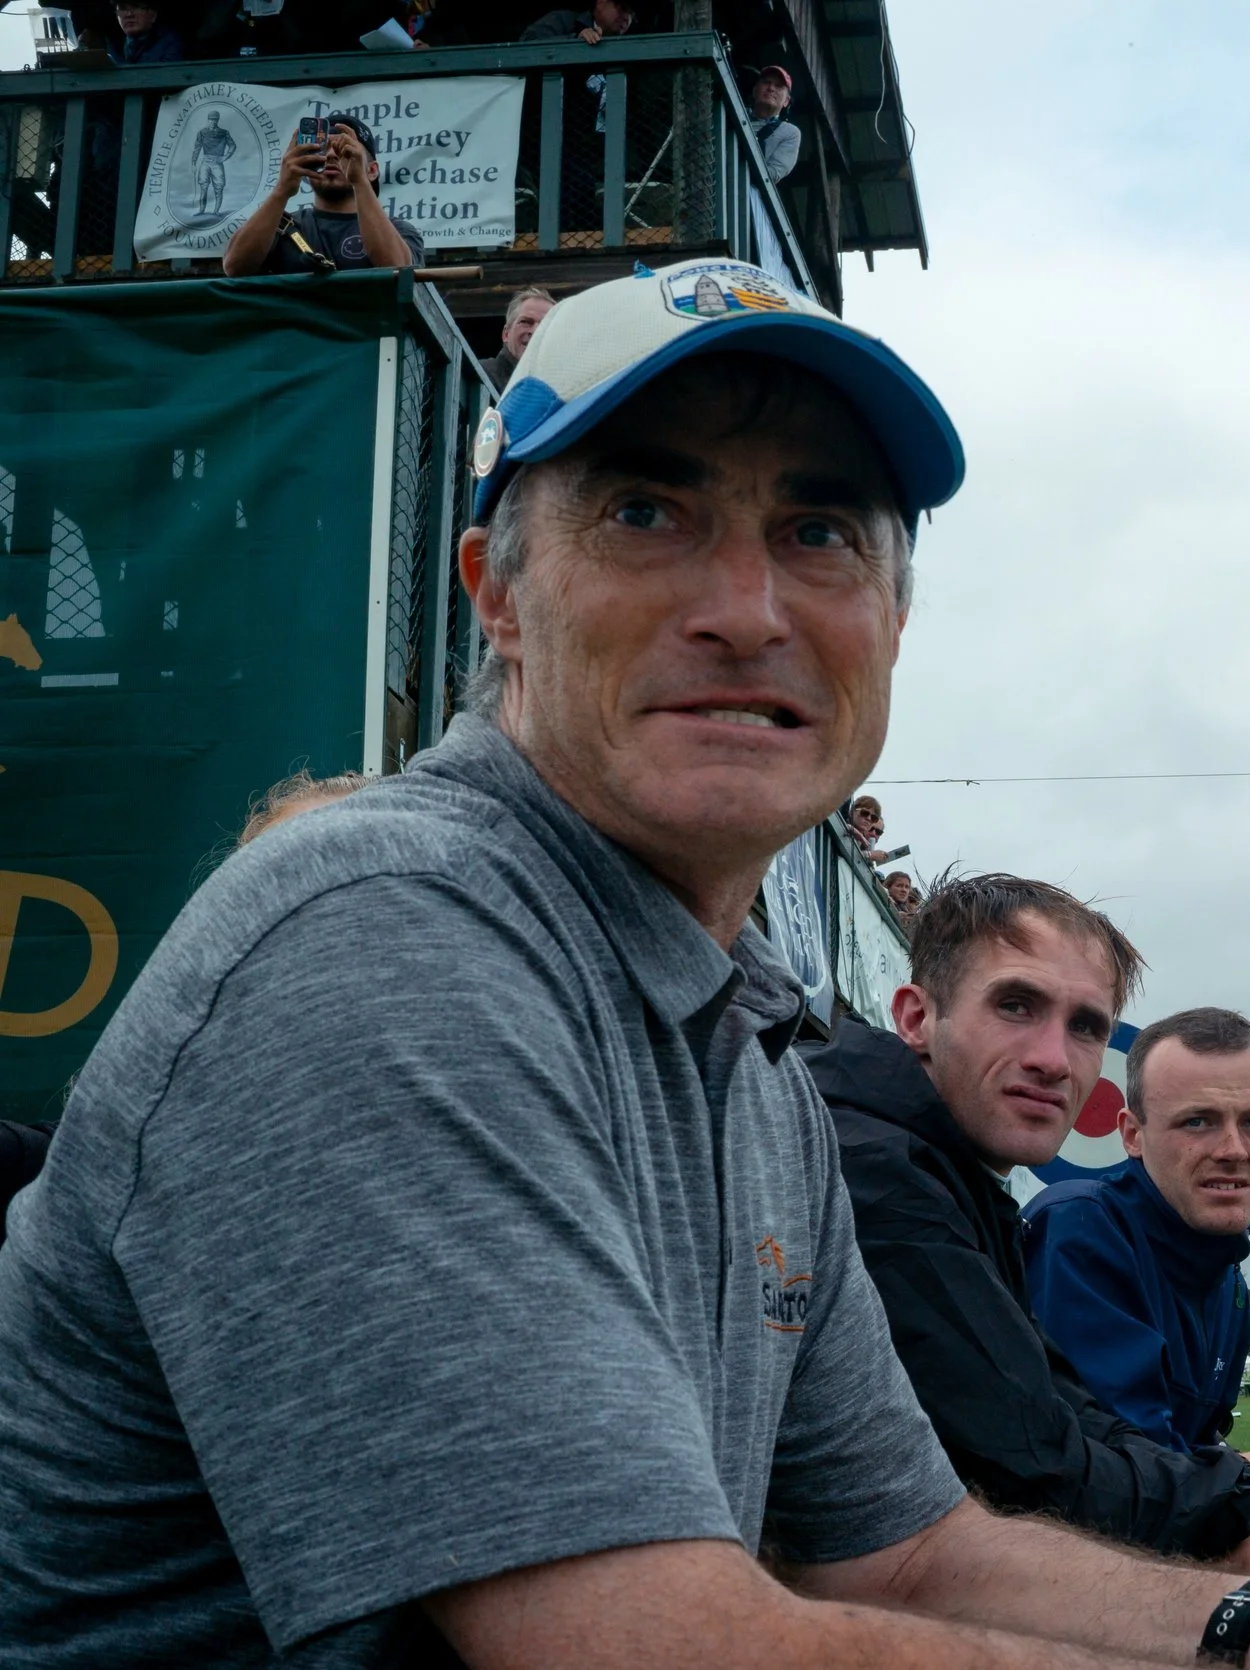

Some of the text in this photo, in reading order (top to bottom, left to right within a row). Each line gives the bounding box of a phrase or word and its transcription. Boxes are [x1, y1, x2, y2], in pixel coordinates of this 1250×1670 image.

[308, 95, 420, 127] Temple
[149, 83, 281, 196] TEMPLE GWATHMEY STEEPLECHASE
[375, 129, 472, 157] thmey
[158, 214, 248, 249] FOUNDATION
[457, 227, 466, 236] &
[469, 225, 512, 238] Change
[0, 870, 119, 1038] D
